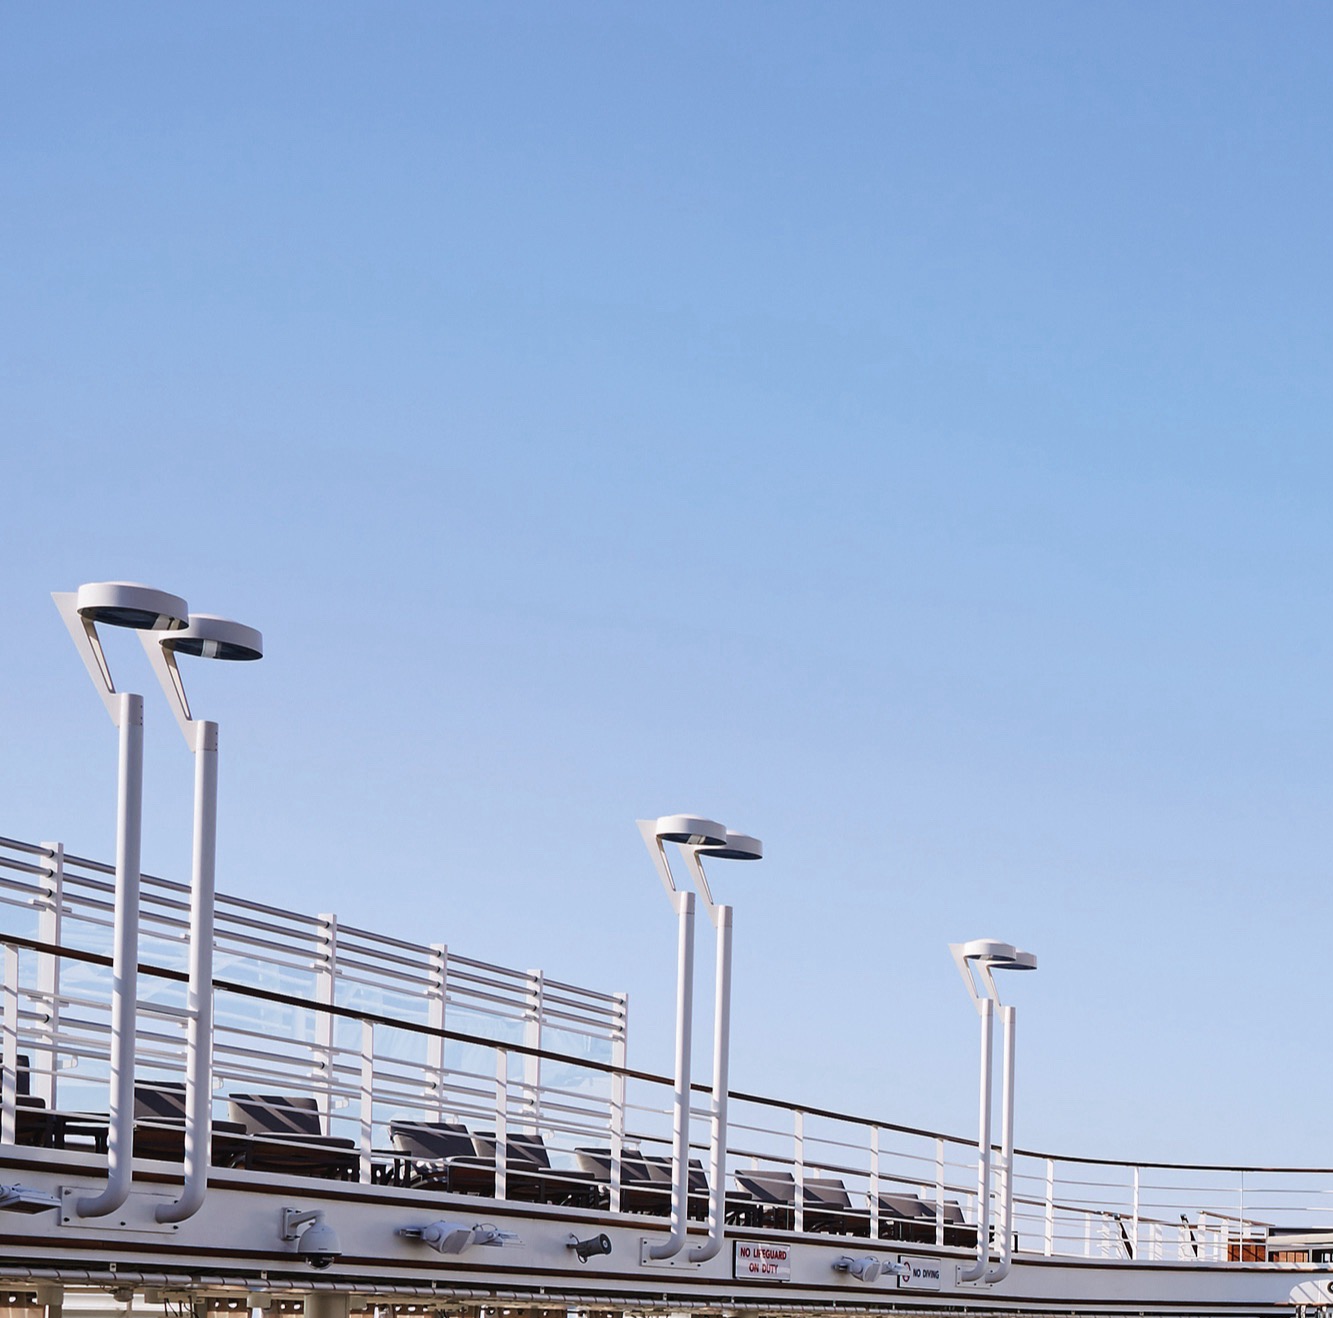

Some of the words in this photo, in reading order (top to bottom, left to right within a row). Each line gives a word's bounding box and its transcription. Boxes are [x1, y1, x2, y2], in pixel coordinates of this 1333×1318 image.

[741, 1247, 751, 1257] NO
[753, 1248, 787, 1260] LIFEGUARD
[749, 1263, 759, 1272] ON
[762, 1264, 778, 1273] DUTY
[913, 1269, 921, 1278] NO
[923, 1269, 940, 1280] DIVING
